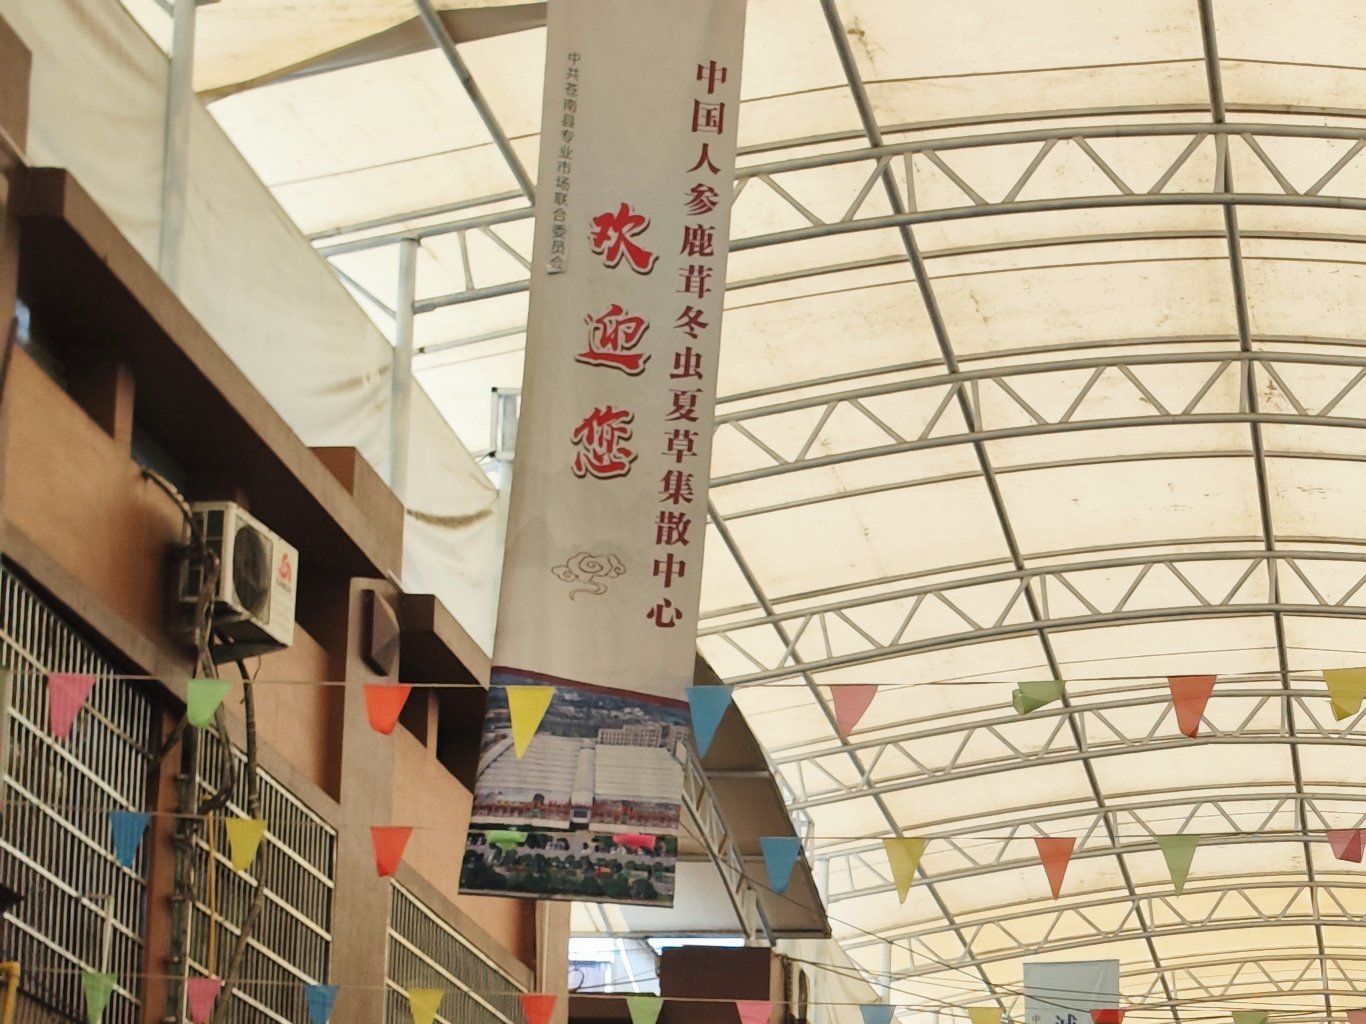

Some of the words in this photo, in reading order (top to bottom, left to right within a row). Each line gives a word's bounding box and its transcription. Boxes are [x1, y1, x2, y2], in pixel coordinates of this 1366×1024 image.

[571, 201, 660, 479] 欢迎您
[645, 59, 728, 630] 中国人参鹿茸冬虫夏草集散中心
